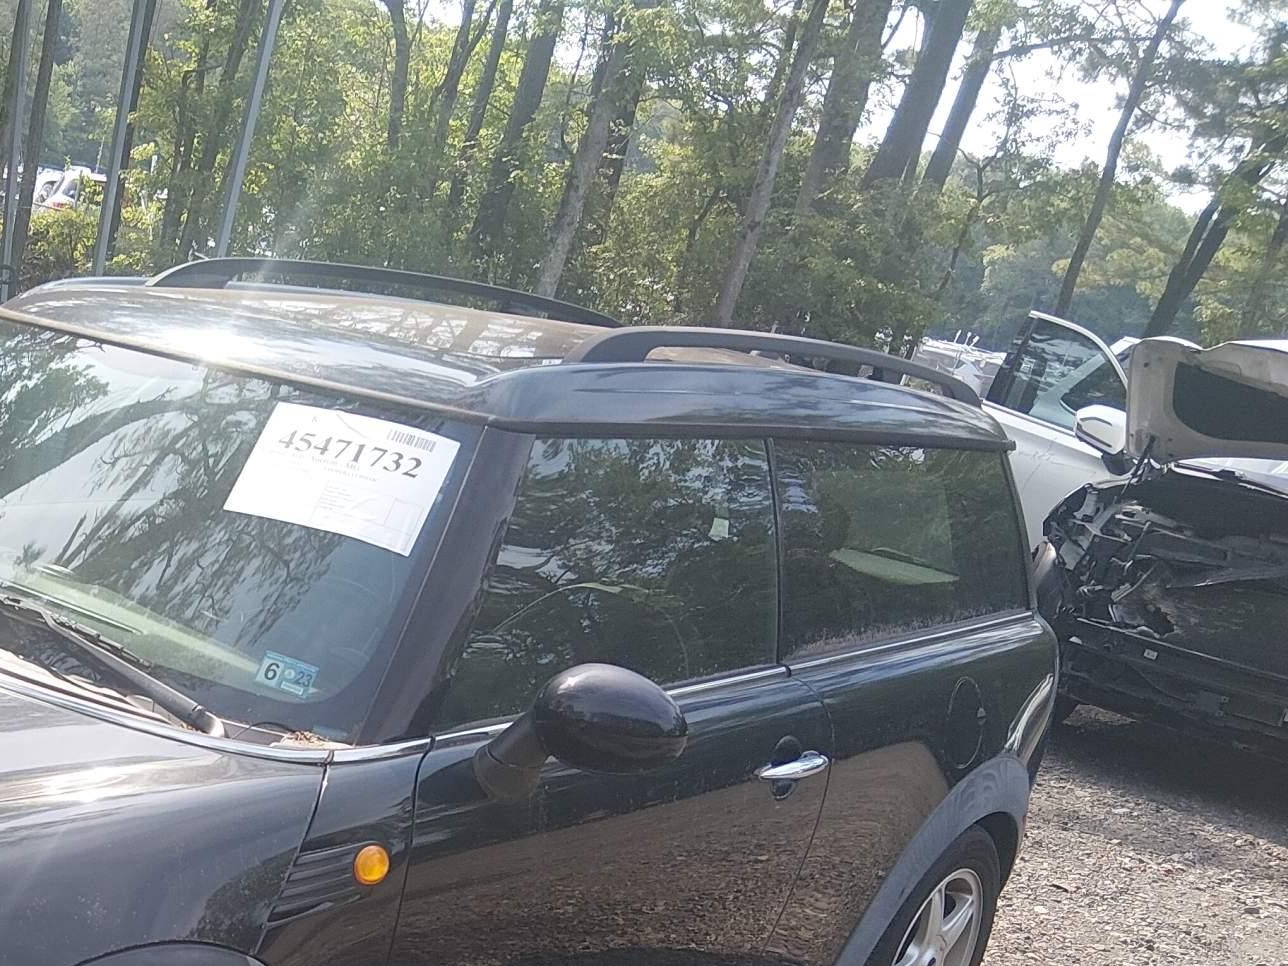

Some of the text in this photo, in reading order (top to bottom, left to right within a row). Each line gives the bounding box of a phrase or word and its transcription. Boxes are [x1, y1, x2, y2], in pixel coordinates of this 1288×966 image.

[278, 429, 424, 480] 45471732
[264, 662, 281, 681] 6
[295, 671, 313, 688] 23
